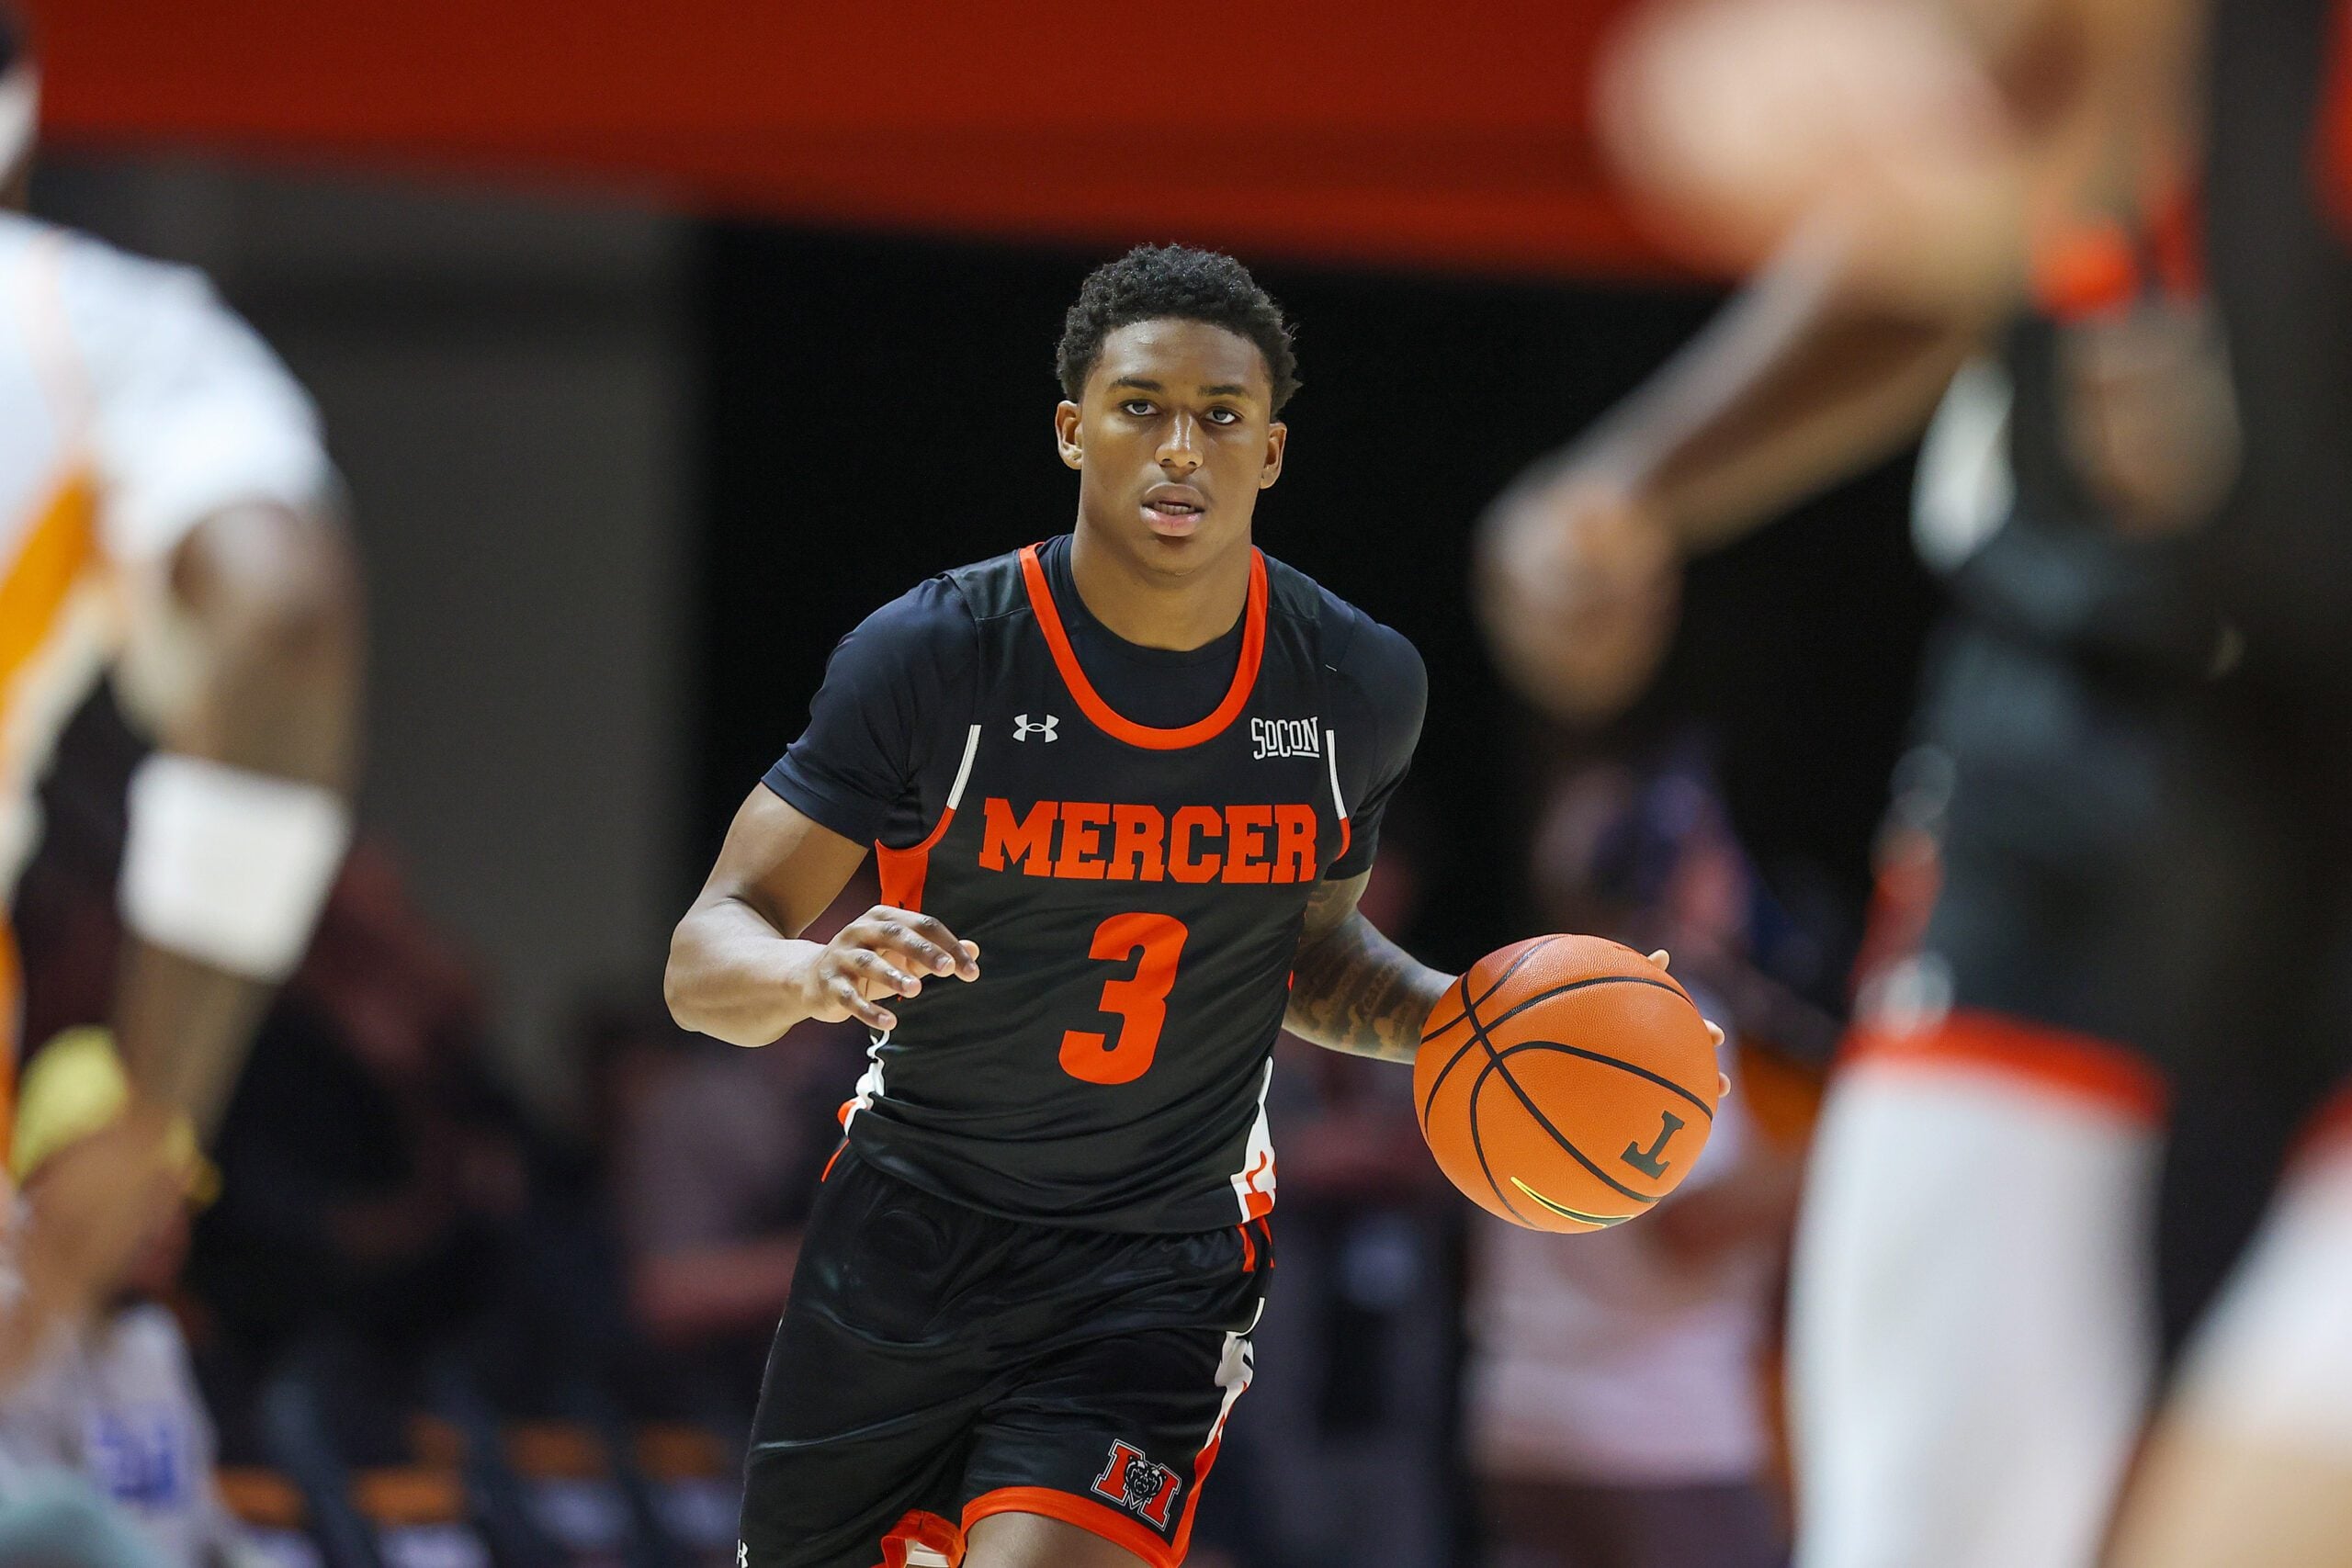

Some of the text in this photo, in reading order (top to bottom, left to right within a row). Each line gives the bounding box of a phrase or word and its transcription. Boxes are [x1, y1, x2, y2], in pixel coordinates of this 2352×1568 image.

[979, 797, 1317, 884] MERCER
[1058, 912, 1189, 1084] 3
[1620, 1110, 1685, 1179] T
